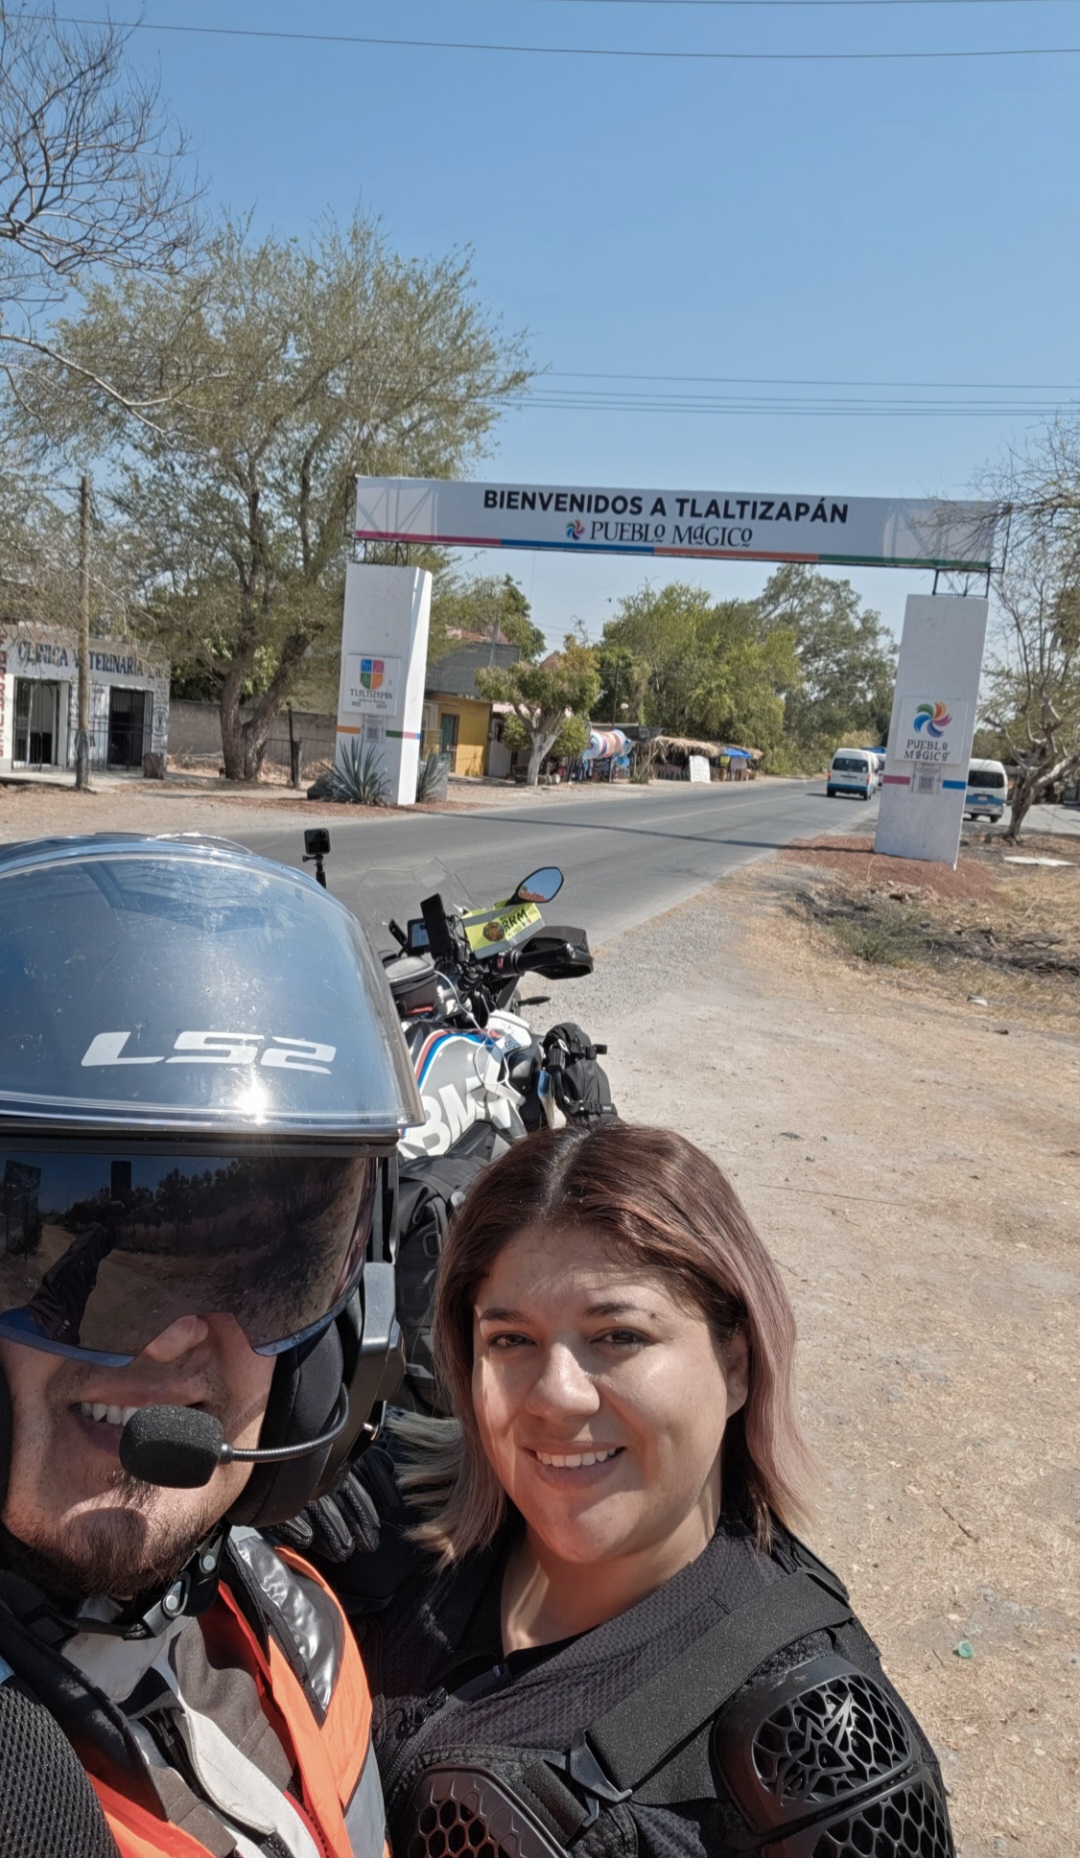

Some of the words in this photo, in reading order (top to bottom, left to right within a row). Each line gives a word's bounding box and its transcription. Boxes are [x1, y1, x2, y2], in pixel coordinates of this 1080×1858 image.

[484, 489, 643, 517] BIENVENIDOS
[650, 498, 667, 516] A
[675, 496, 849, 524] TLALTIZAPÁN
[73, 648, 144, 677] VTERINARIA
[501, 908, 528, 932] RRM
[80, 1030, 337, 1075] LS2
